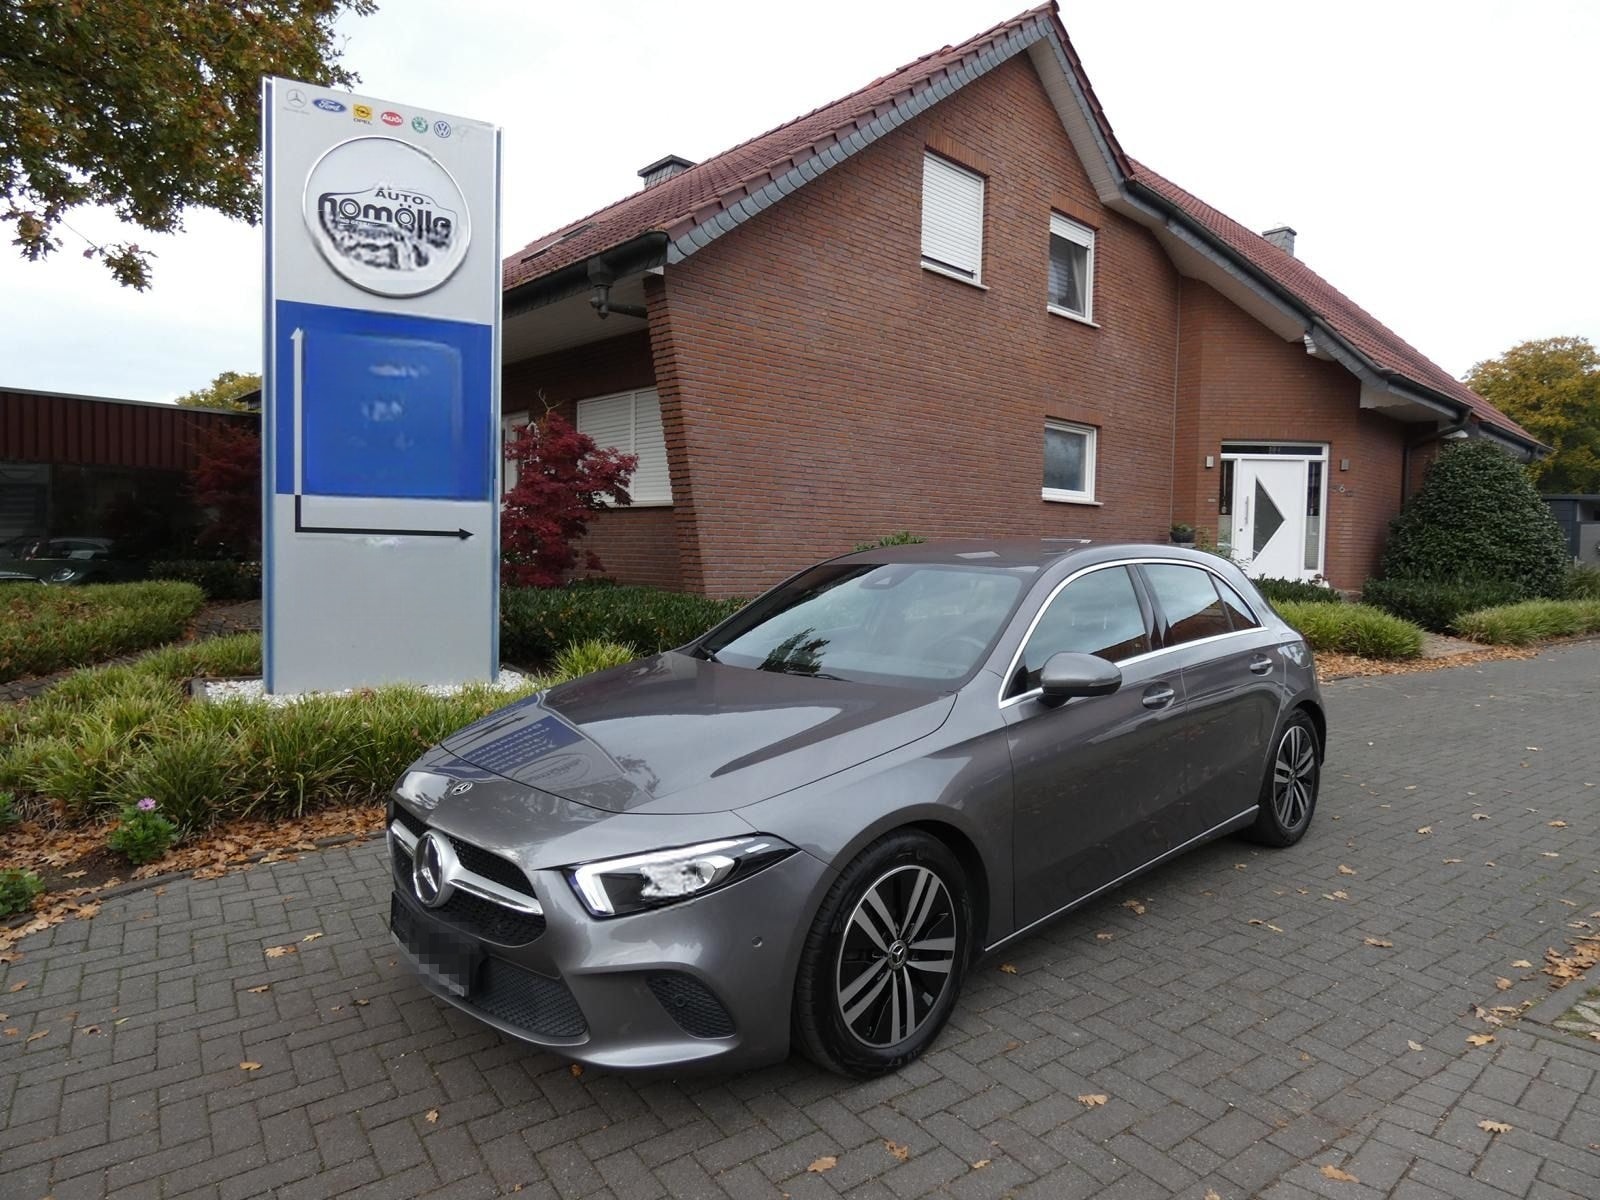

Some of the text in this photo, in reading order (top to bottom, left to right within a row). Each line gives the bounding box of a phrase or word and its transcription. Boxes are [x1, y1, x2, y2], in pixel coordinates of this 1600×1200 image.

[318, 99, 341, 112] Ford
[382, 113, 403, 124] Audi
[375, 190, 431, 205] AUTO-
